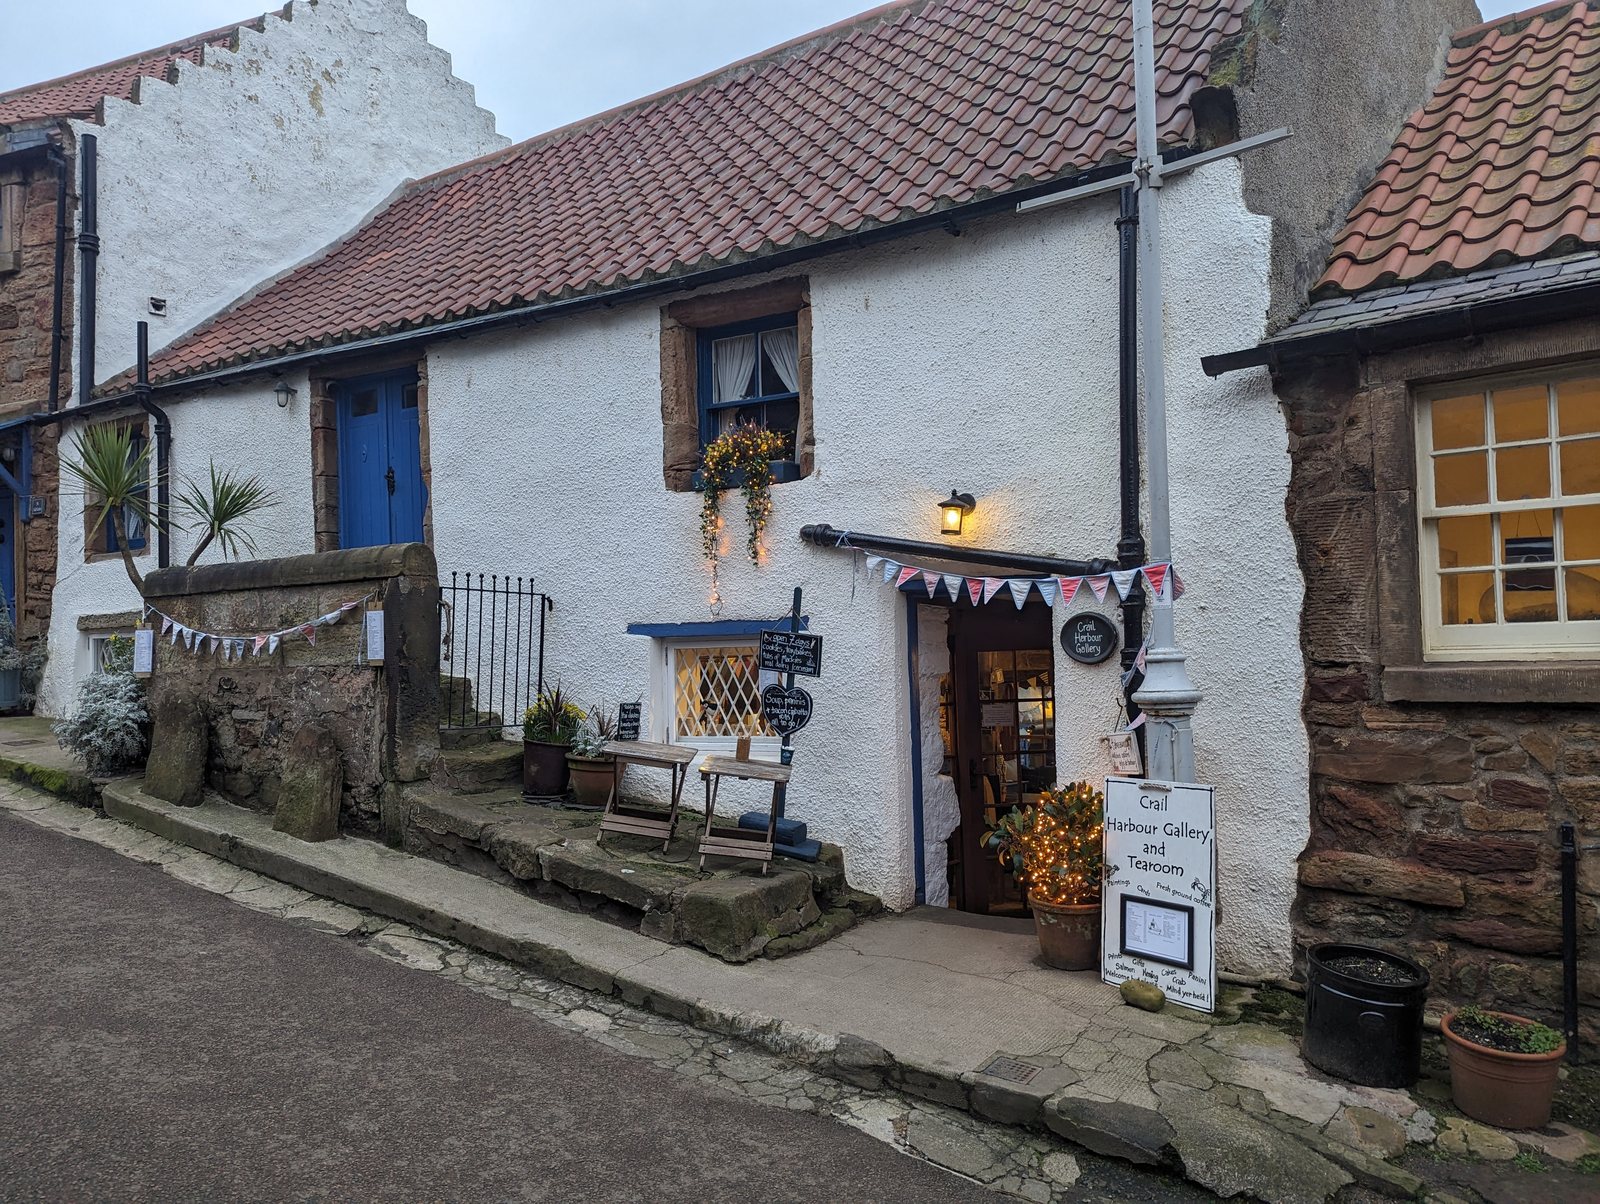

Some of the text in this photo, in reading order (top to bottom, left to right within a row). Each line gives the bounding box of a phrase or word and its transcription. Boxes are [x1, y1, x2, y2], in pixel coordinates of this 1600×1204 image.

[1078, 620, 1096, 632] Crail
[789, 634, 795, 646] 7
[1075, 632, 1103, 644] Harbour
[1075, 642, 1101, 657] Gallery
[1139, 795, 1168, 811] Crail
[1107, 816, 1210, 845] Harbour Gallery
[1142, 841, 1166, 857] and
[1127, 855, 1184, 877] Tearoom
[1107, 880, 1131, 888] Paintings
[1137, 884, 1151, 897] Cards
[1156, 882, 1212, 908] Fresh ground coffee
[1115, 962, 1136, 973] Salmon
[1132, 958, 1145, 968] Gifts
[1105, 968, 1130, 980] Welcome
[1188, 971, 1207, 985] Panini
[1172, 976, 1187, 986] Crab
[1166, 985, 1181, 995] Mind
